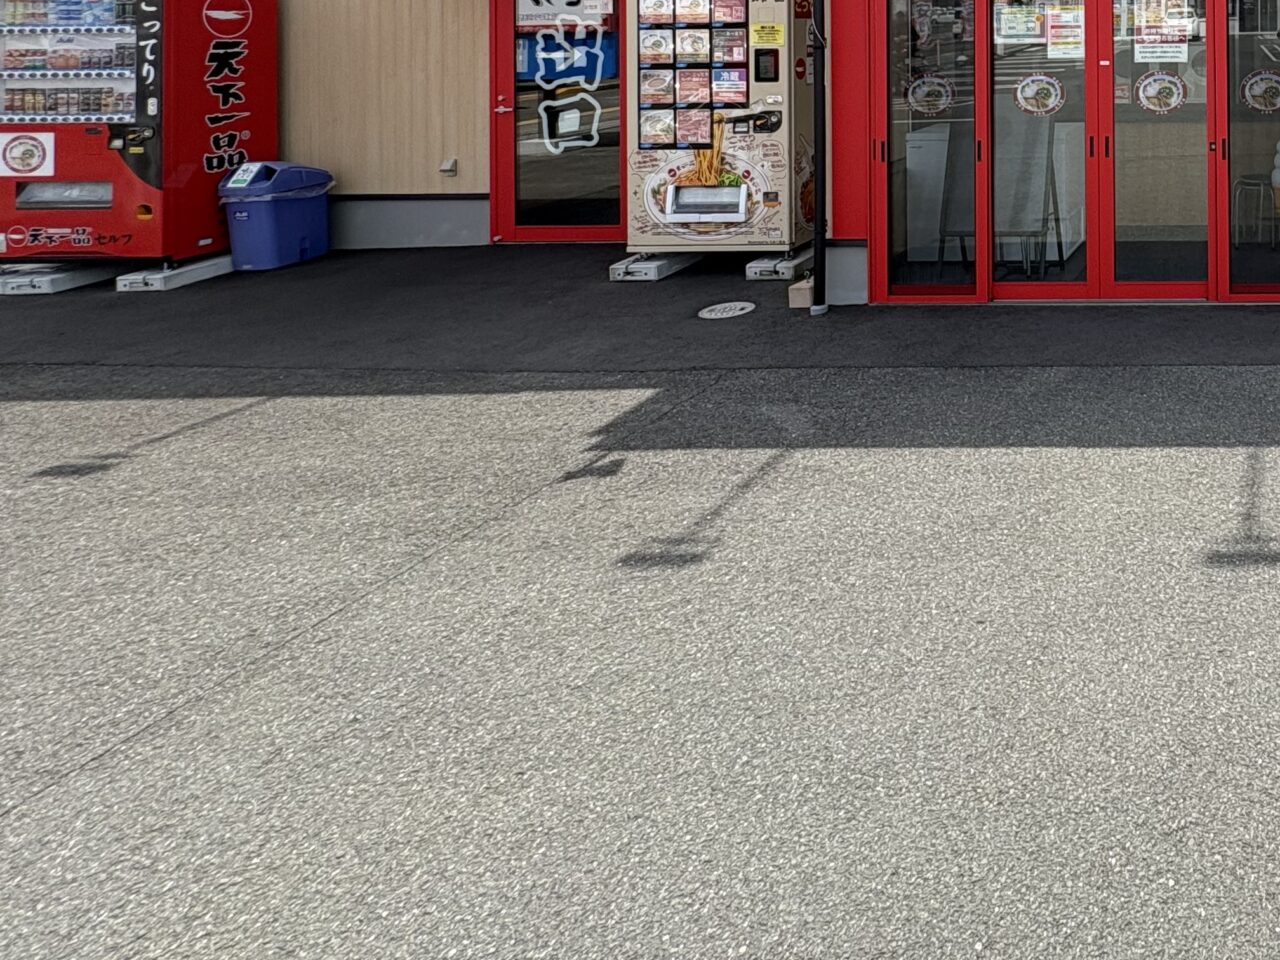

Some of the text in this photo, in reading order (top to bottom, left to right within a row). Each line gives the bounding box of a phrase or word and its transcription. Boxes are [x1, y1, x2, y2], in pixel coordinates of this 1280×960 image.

[204, 40, 251, 174] 天下一品
[535, 13, 605, 154] 出口
[27, 227, 94, 247] 天下一品
